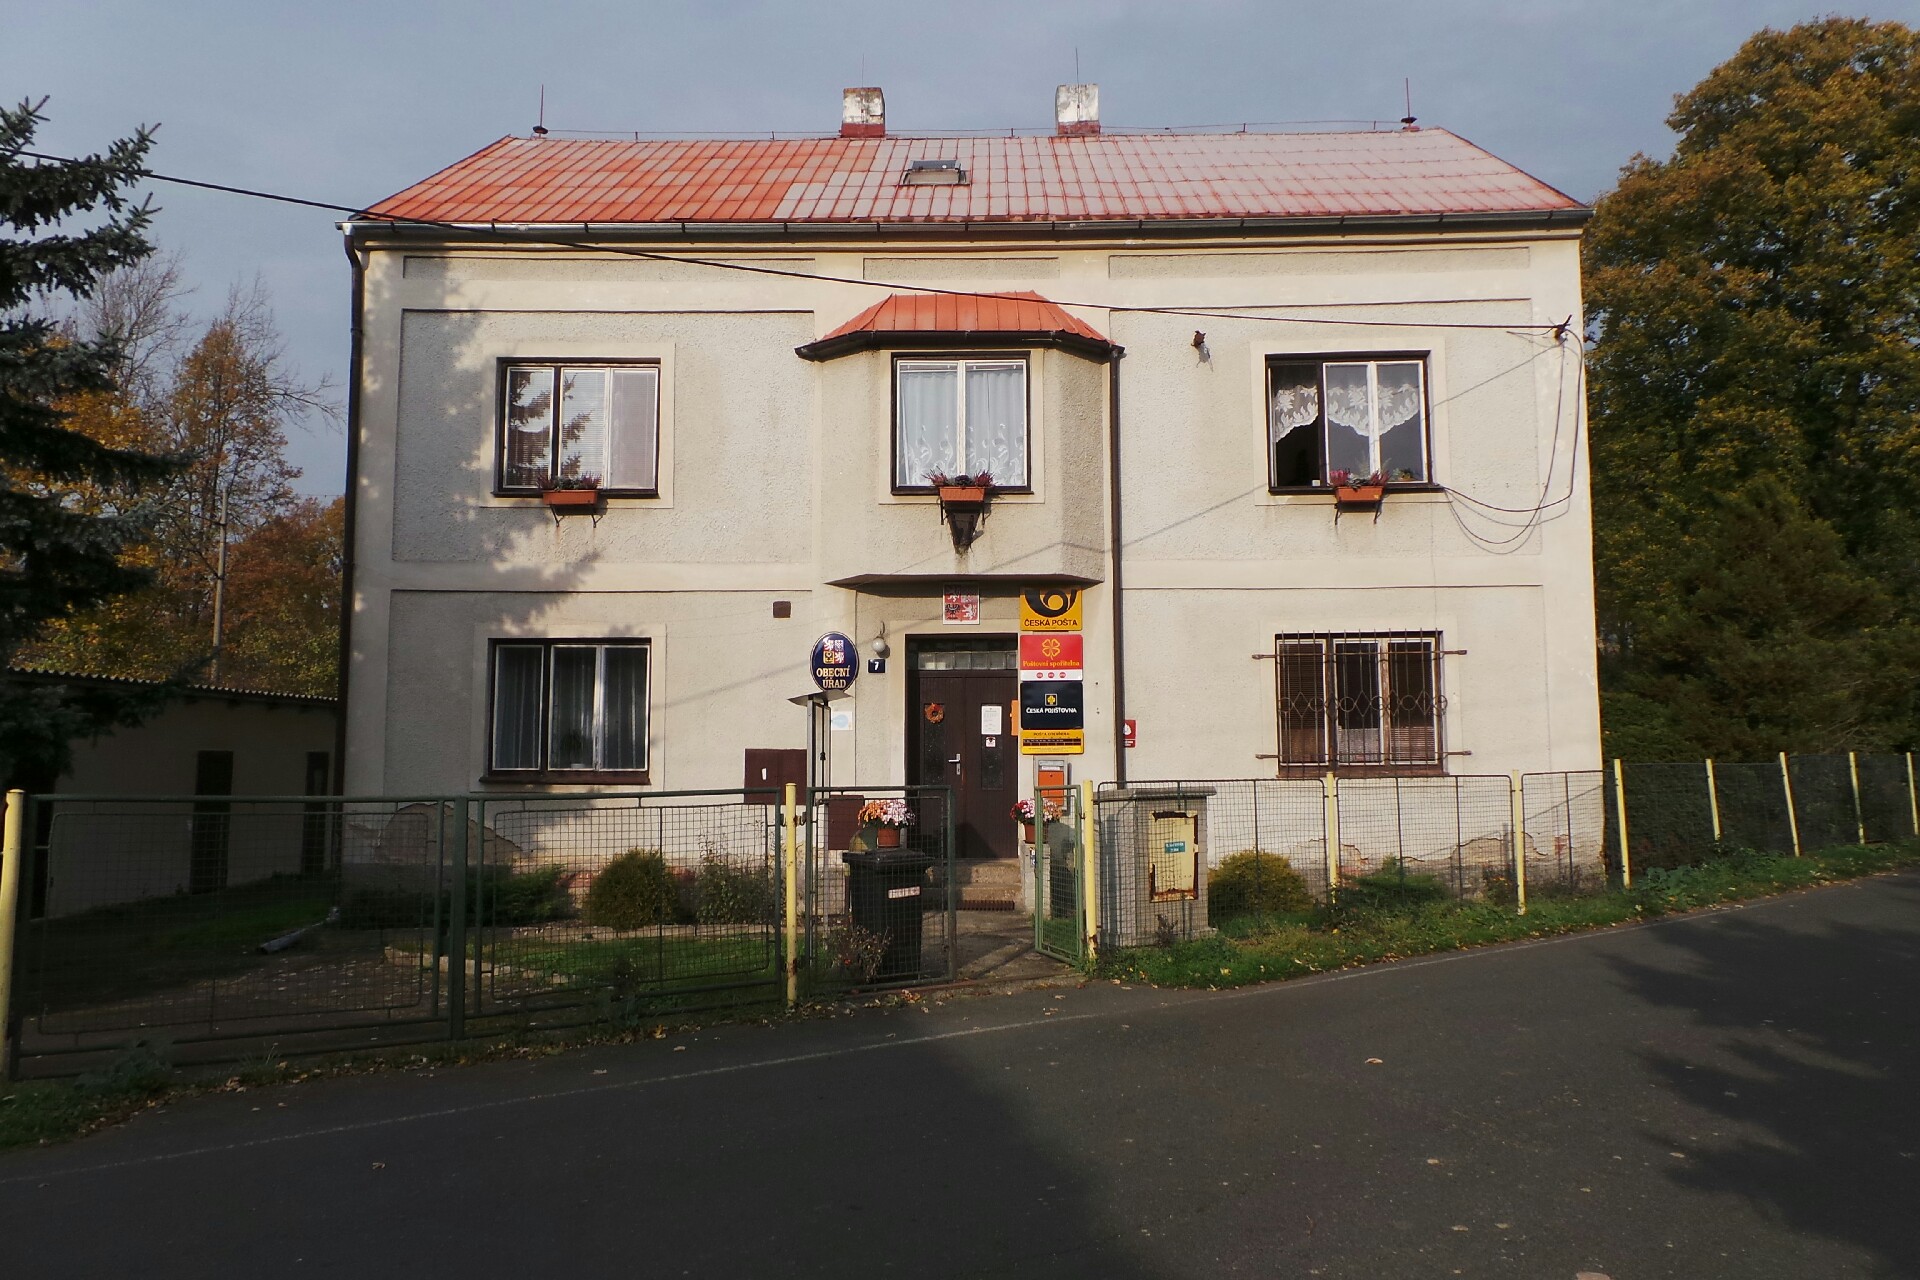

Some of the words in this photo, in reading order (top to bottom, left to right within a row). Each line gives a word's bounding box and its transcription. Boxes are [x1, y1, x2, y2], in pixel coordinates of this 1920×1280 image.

[1024, 618, 1050, 626] ČESKÁ
[1052, 618, 1078, 626] POŠTA
[874, 661, 879, 671] 7
[1050, 660, 1080, 668] spořitelna
[816, 665, 850, 677] OBECNÍ
[822, 676, 846, 689] ÚŘAD
